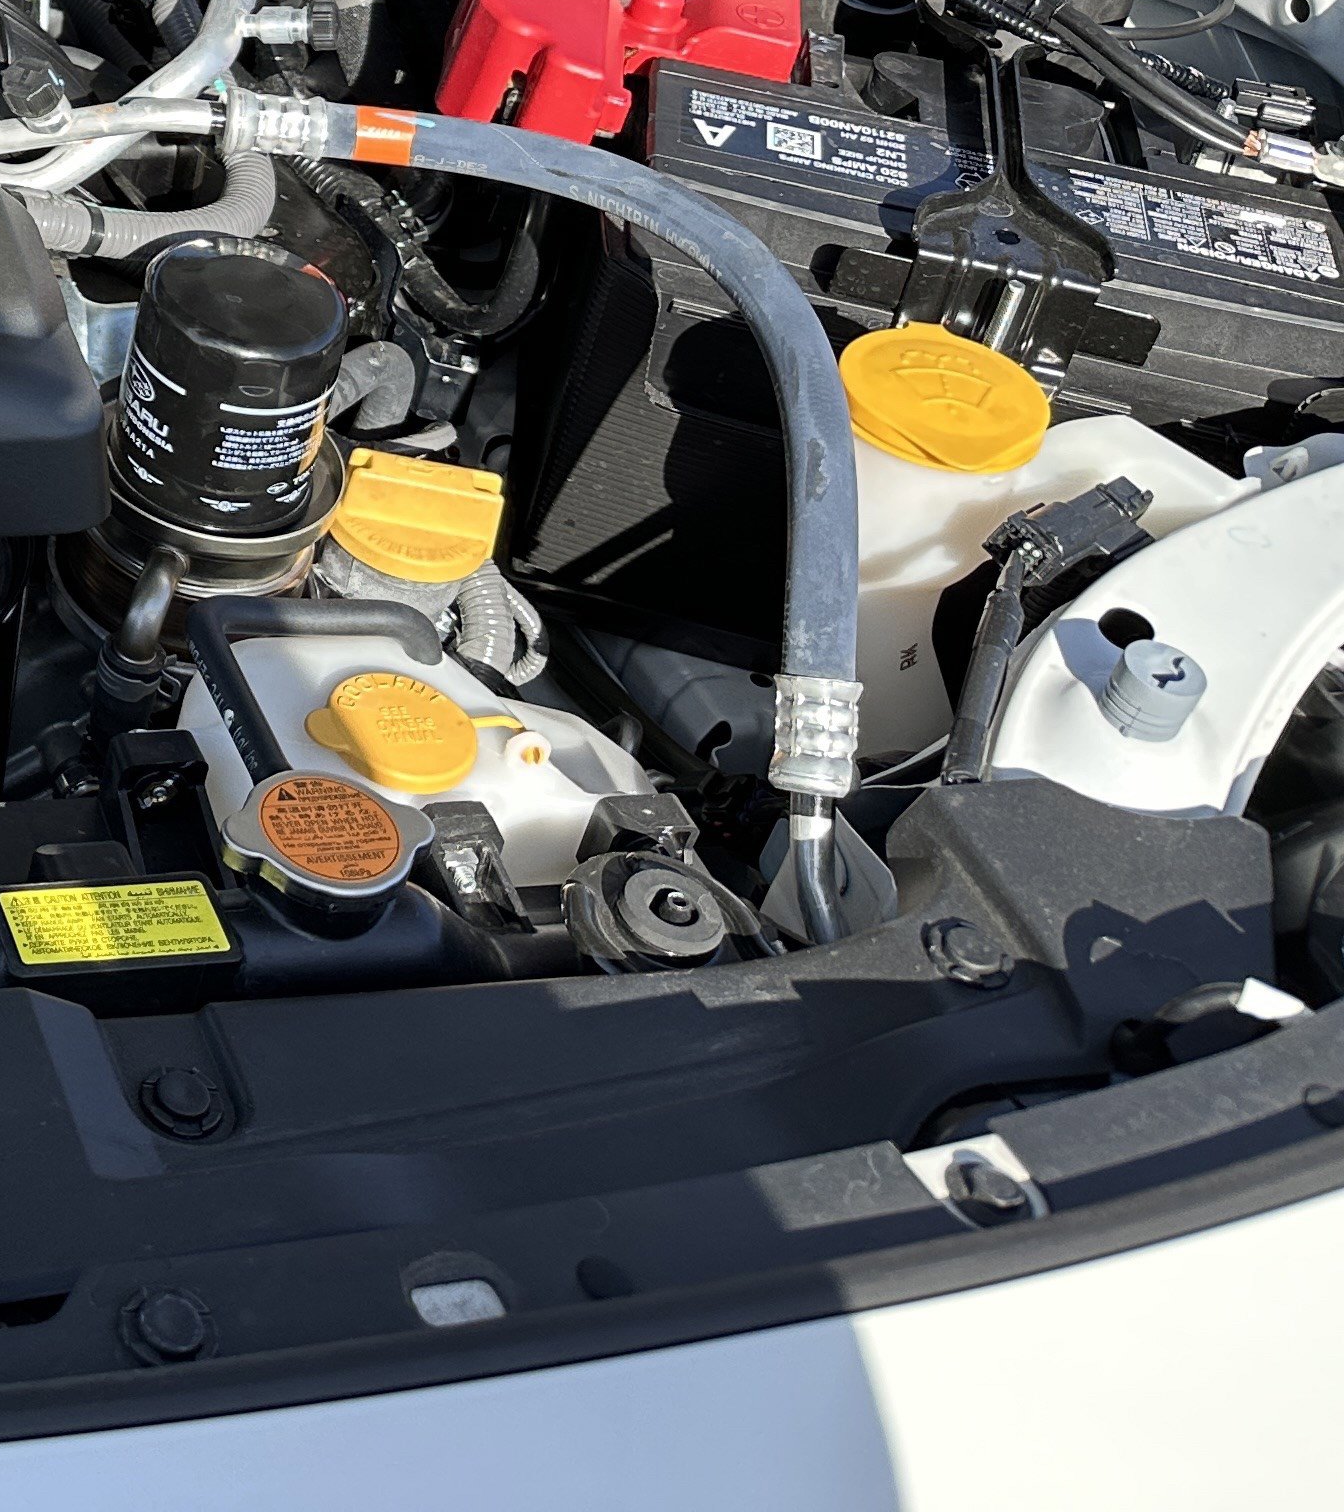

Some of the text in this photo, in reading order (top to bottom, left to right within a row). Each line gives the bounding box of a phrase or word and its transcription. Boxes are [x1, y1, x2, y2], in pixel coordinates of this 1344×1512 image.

[693, 118, 737, 148] A
[837, 148, 908, 169] GROUP SIZE
[875, 147, 907, 161] LN2
[778, 153, 909, 188] COLD CRANKING AMPS
[831, 156, 908, 180] 620 AMPS
[337, 674, 440, 707] COOLANT
[379, 705, 411, 719] SEE
[295, 786, 346, 796] WARNING
[272, 820, 301, 829] NEVER
[304, 818, 328, 827] OPEN
[331, 816, 359, 825] WHEN
[306, 851, 386, 865] AVERTISSEMENT
[44, 894, 77, 904] CAUTION
[81, 890, 121, 901] ATTENTION
